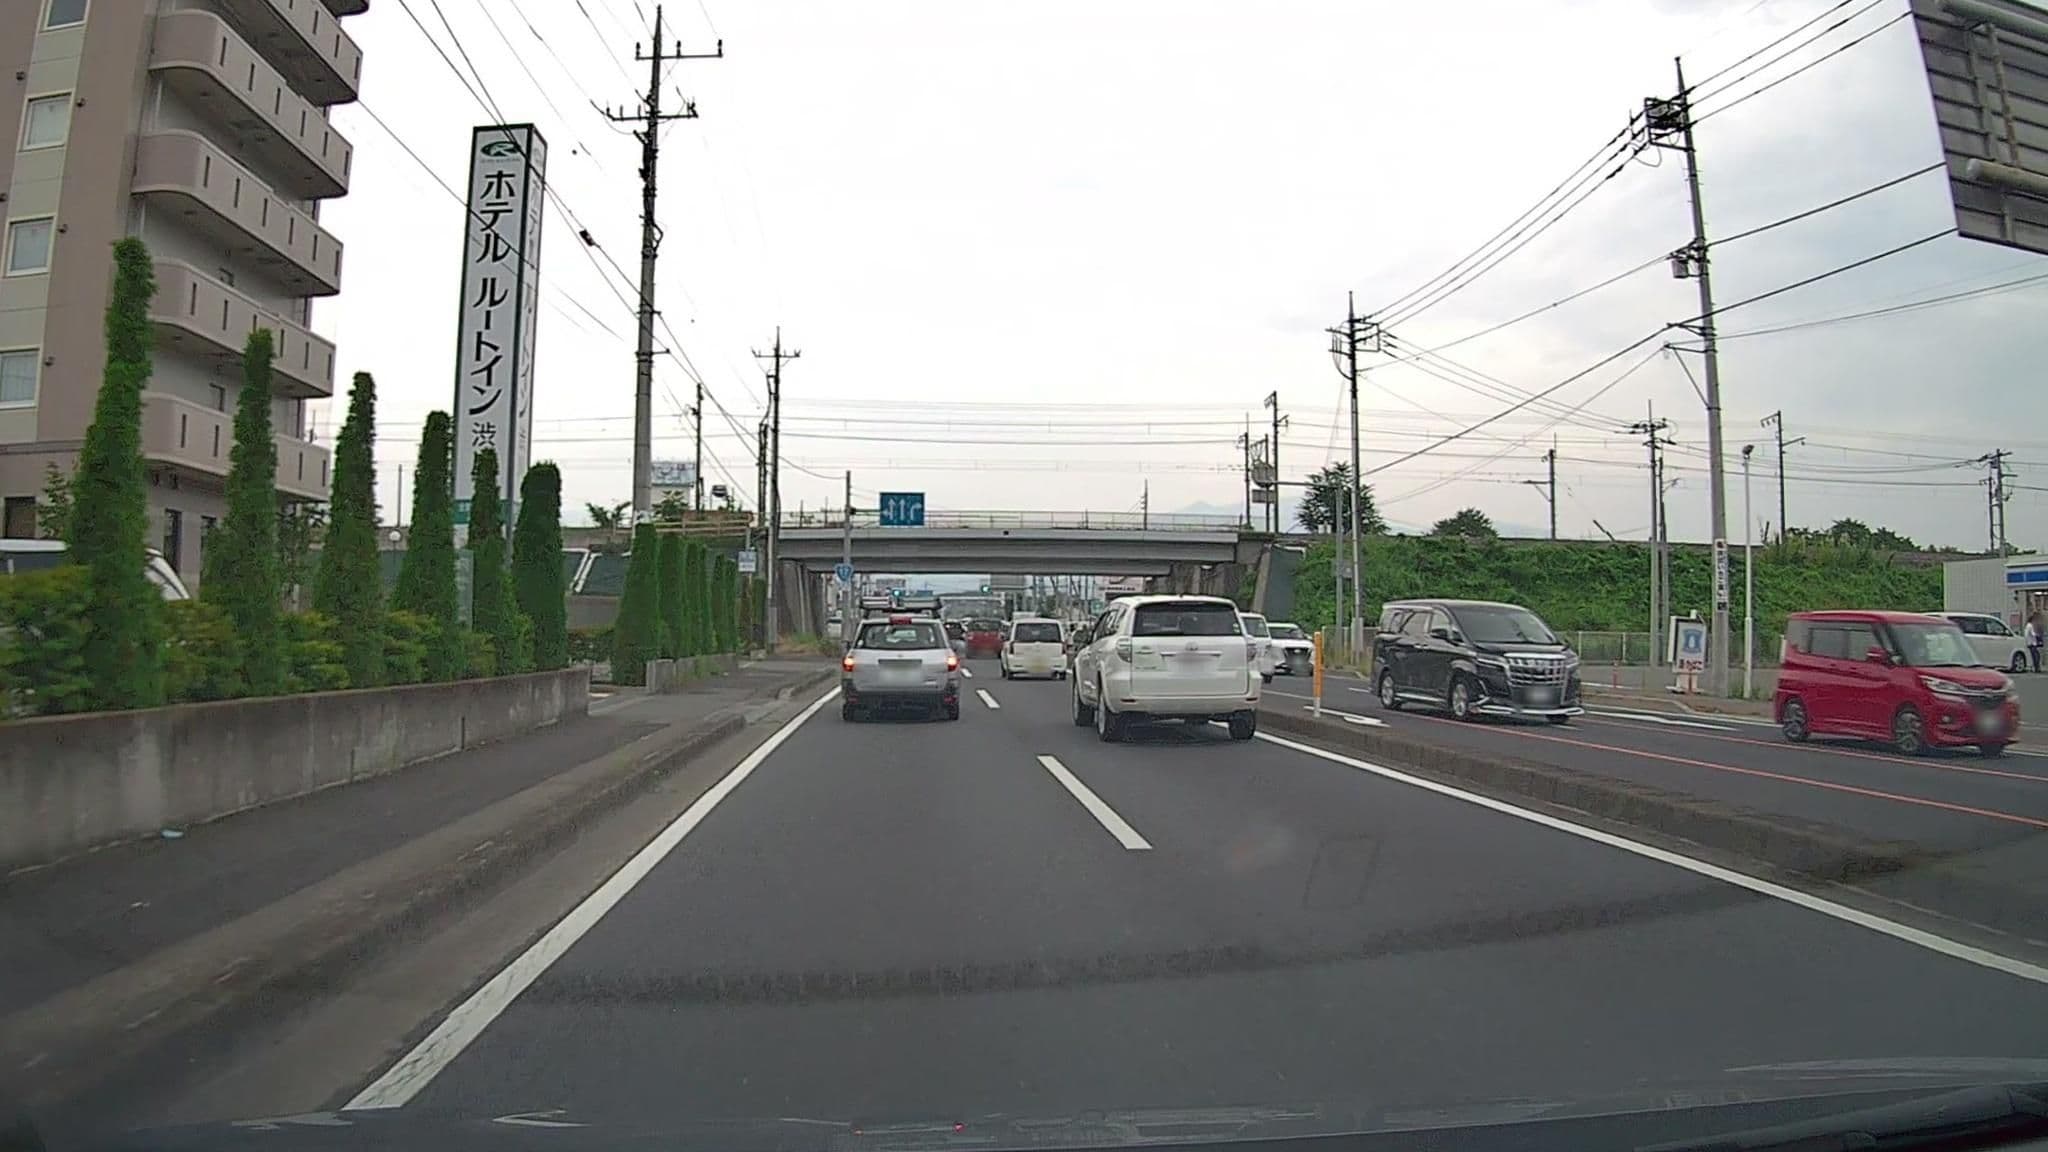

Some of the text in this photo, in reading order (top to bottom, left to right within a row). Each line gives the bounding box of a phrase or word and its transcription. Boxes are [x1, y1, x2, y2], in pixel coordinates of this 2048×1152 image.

[475, 170, 517, 263] ホテル
[469, 277, 509, 416] ルートイン
